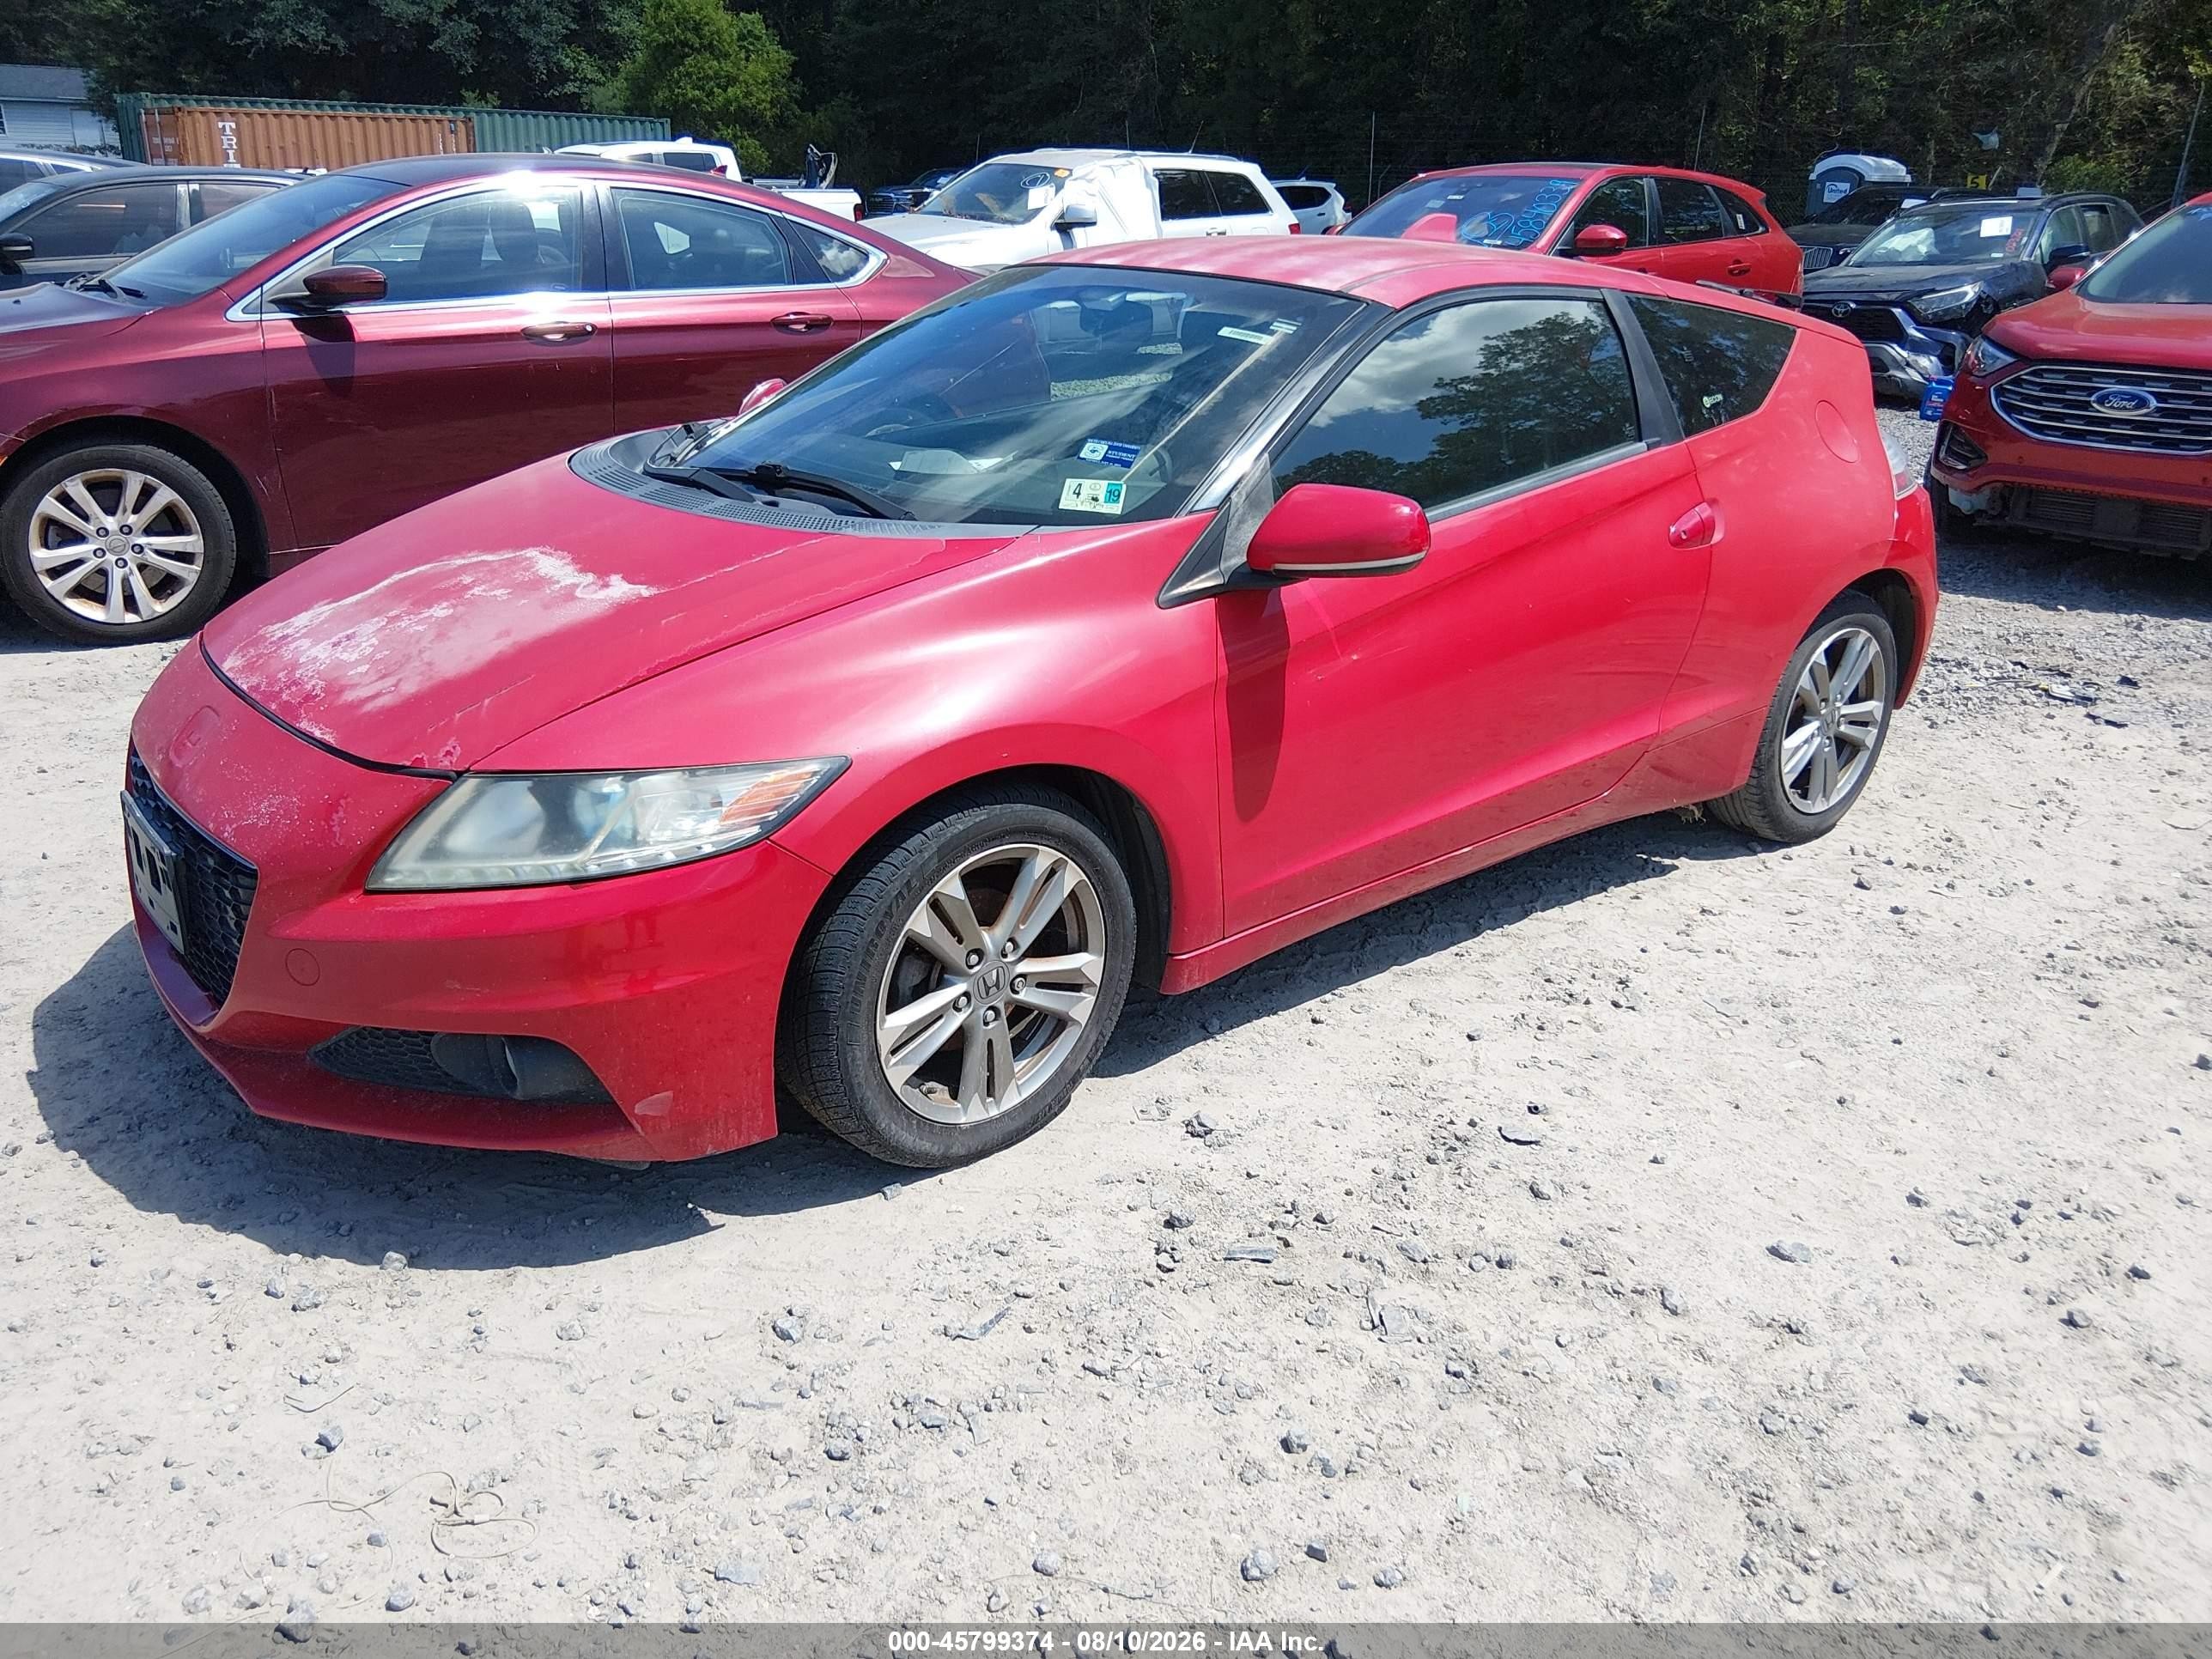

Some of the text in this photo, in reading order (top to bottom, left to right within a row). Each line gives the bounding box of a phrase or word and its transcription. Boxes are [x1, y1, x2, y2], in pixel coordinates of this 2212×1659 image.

[2105, 394, 2138, 409] Ford
[1073, 483, 1121, 502] 4 19
